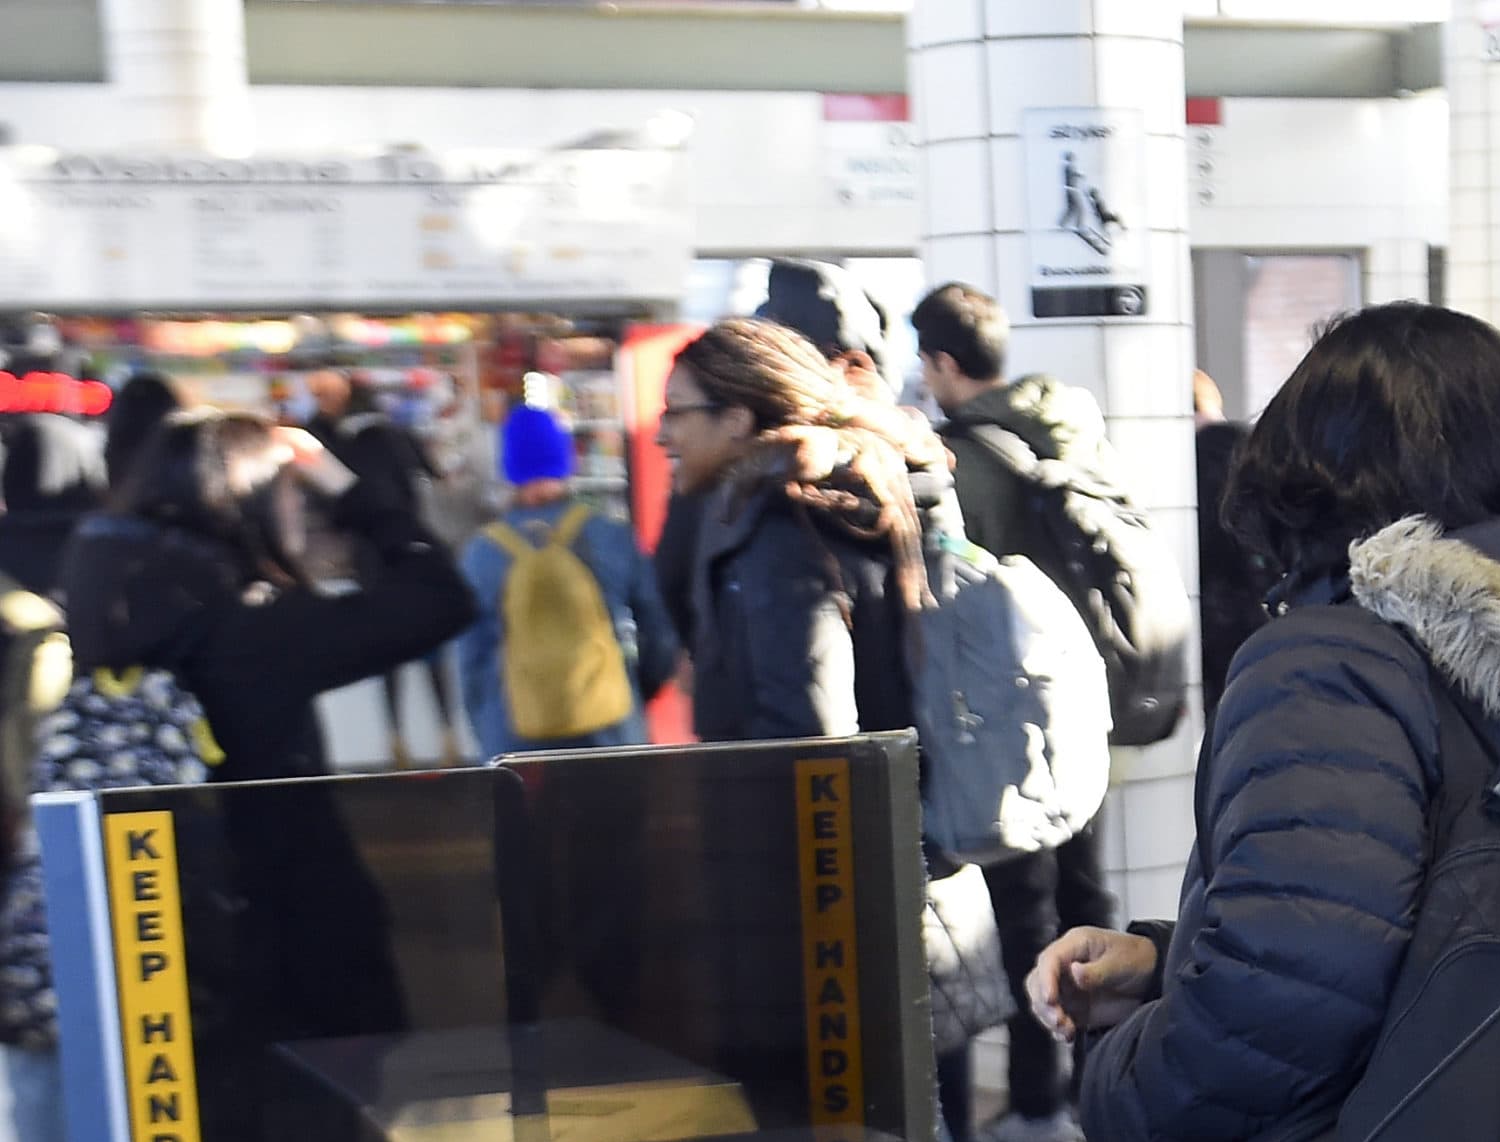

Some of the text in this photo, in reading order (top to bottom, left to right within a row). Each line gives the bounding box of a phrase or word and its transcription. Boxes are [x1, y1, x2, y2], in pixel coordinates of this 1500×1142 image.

[127, 829, 169, 983] KEEP
[810, 774, 843, 913] KEEP
[815, 941, 850, 1114] HANDS
